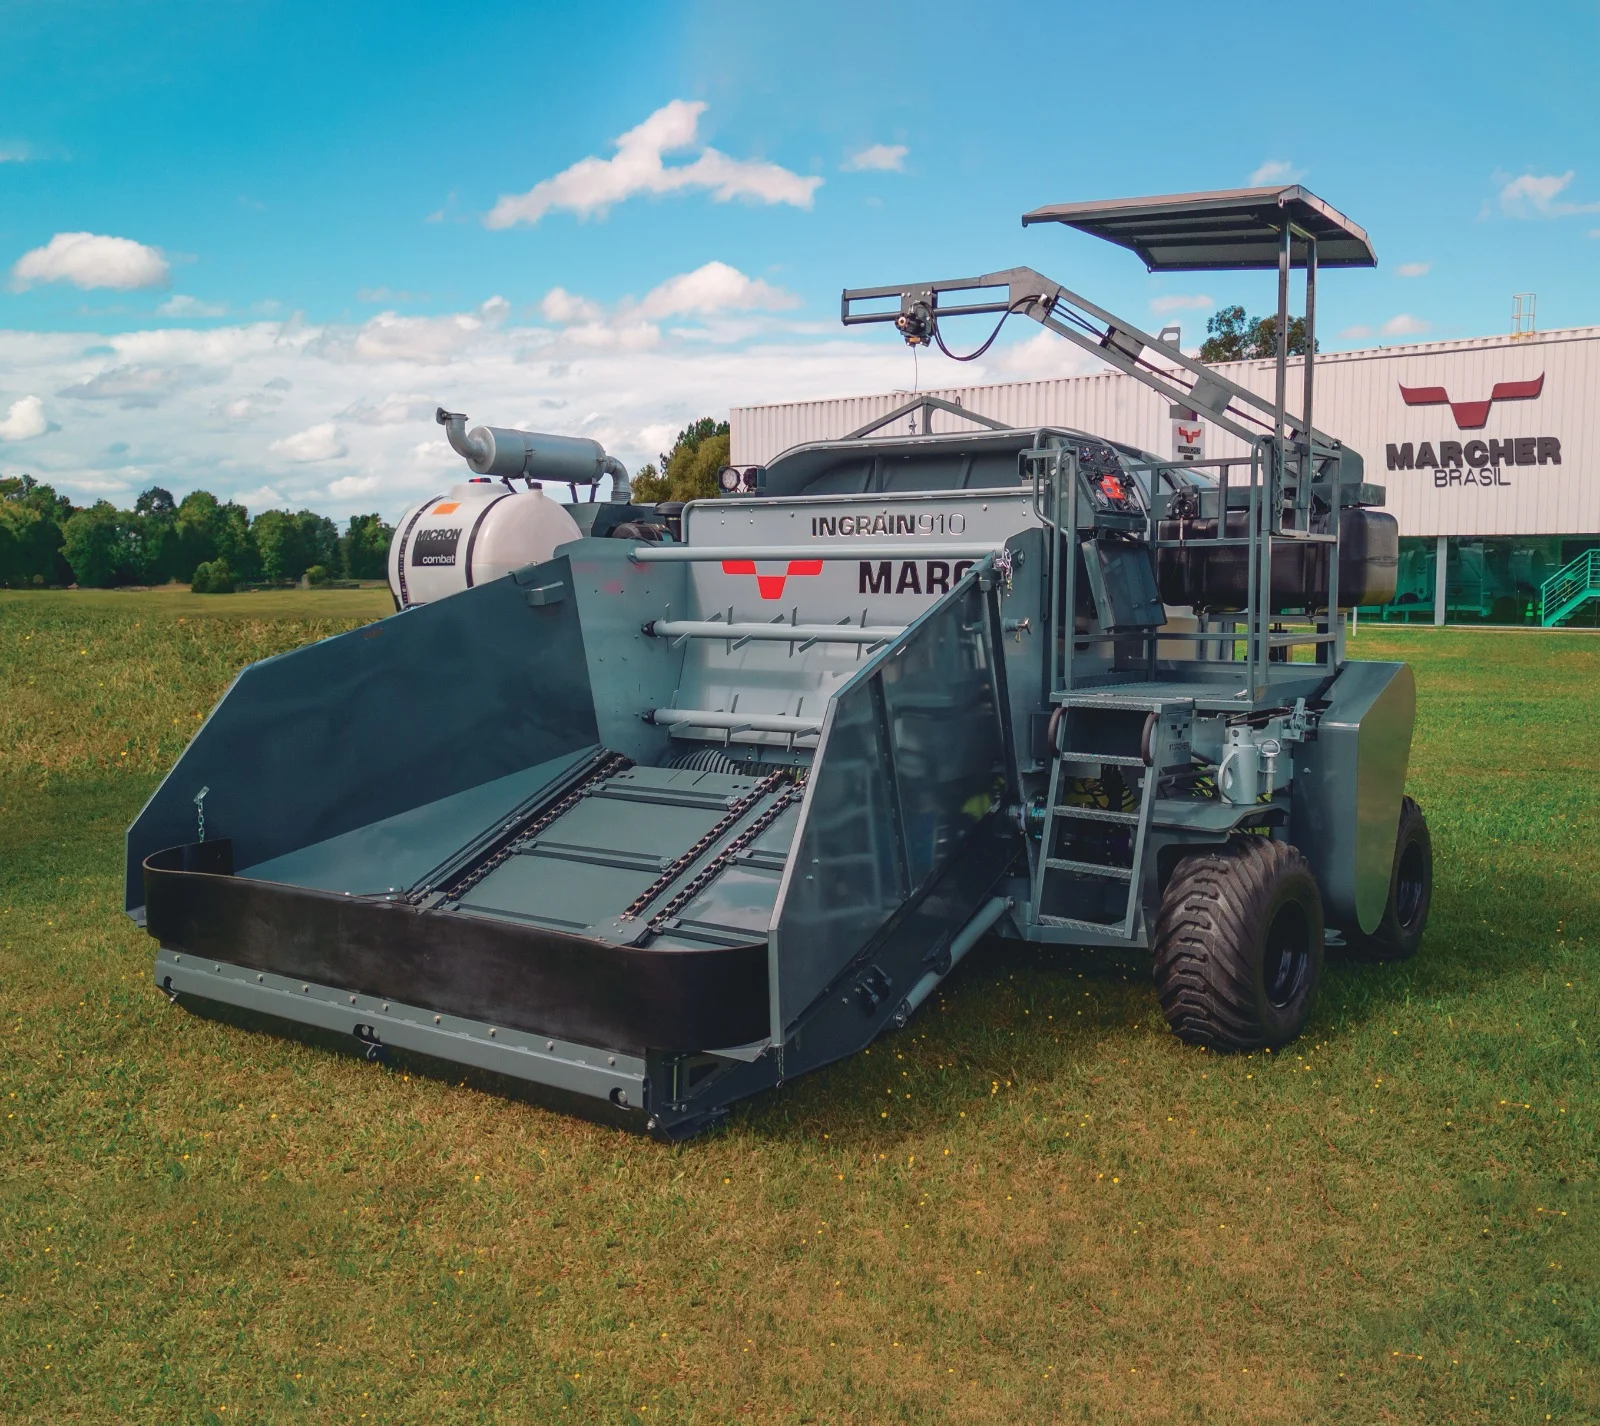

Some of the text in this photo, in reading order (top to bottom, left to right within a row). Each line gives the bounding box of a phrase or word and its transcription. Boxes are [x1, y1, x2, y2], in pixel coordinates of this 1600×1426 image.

[1386, 437, 1561, 470] MARCHER
[1434, 467, 1511, 488] BRASIL
[416, 528, 463, 540] MICRON
[811, 513, 966, 537] INGRAIN910
[422, 554, 455, 564] combat
